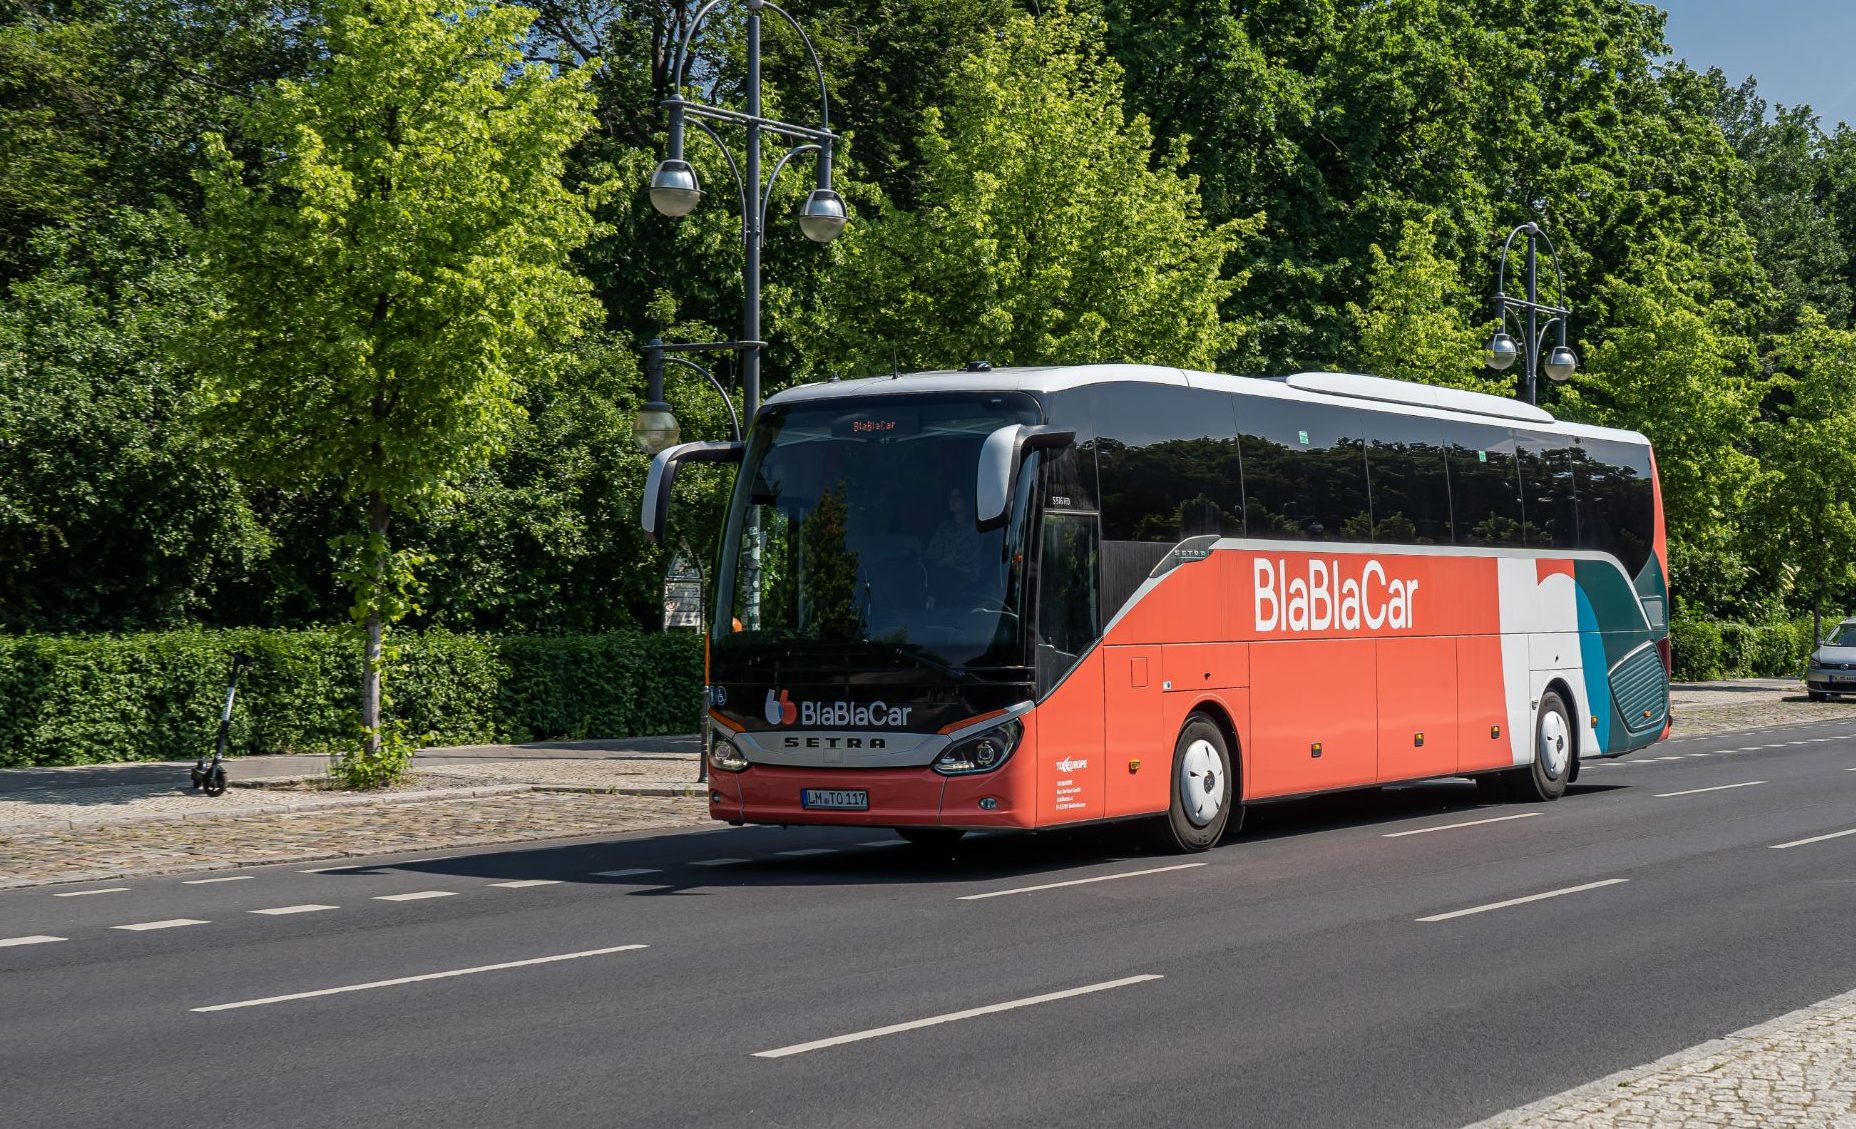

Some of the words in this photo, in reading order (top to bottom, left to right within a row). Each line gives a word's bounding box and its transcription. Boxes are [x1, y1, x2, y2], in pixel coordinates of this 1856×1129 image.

[1174, 549, 1206, 557] SETRA
[1253, 557, 1419, 632] BlaBlaCar
[801, 700, 912, 726] BlaBlaCar
[784, 737, 886, 749] SETRA
